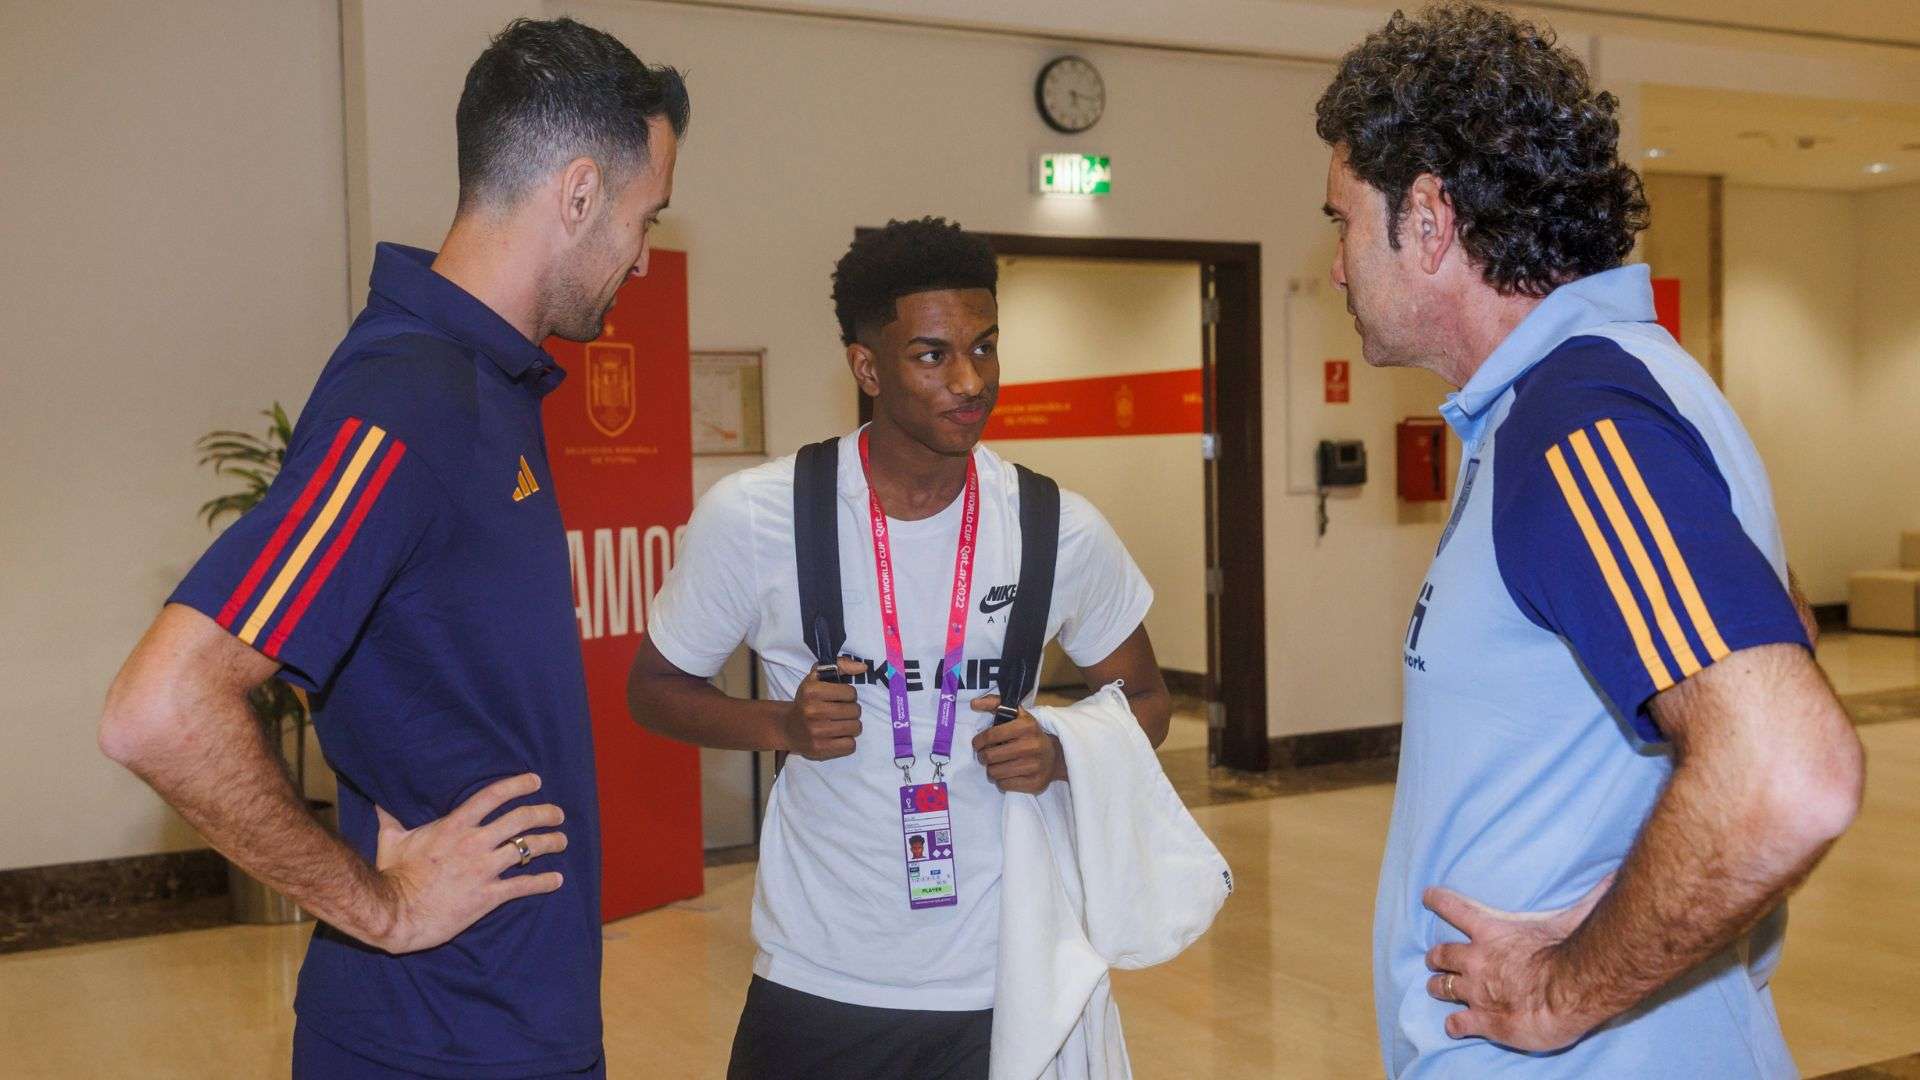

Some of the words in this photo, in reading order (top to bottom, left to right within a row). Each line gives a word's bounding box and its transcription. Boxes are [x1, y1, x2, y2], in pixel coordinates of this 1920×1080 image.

[966, 491, 976, 524] WORLD
[964, 524, 973, 541] CUP
[878, 541, 887, 559] CUP
[566, 524, 688, 639] AMO
[880, 560, 890, 593] WORLD
[986, 584, 1016, 602] NIKE
[885, 593, 893, 613] FIFA
[987, 615, 1007, 624] AI
